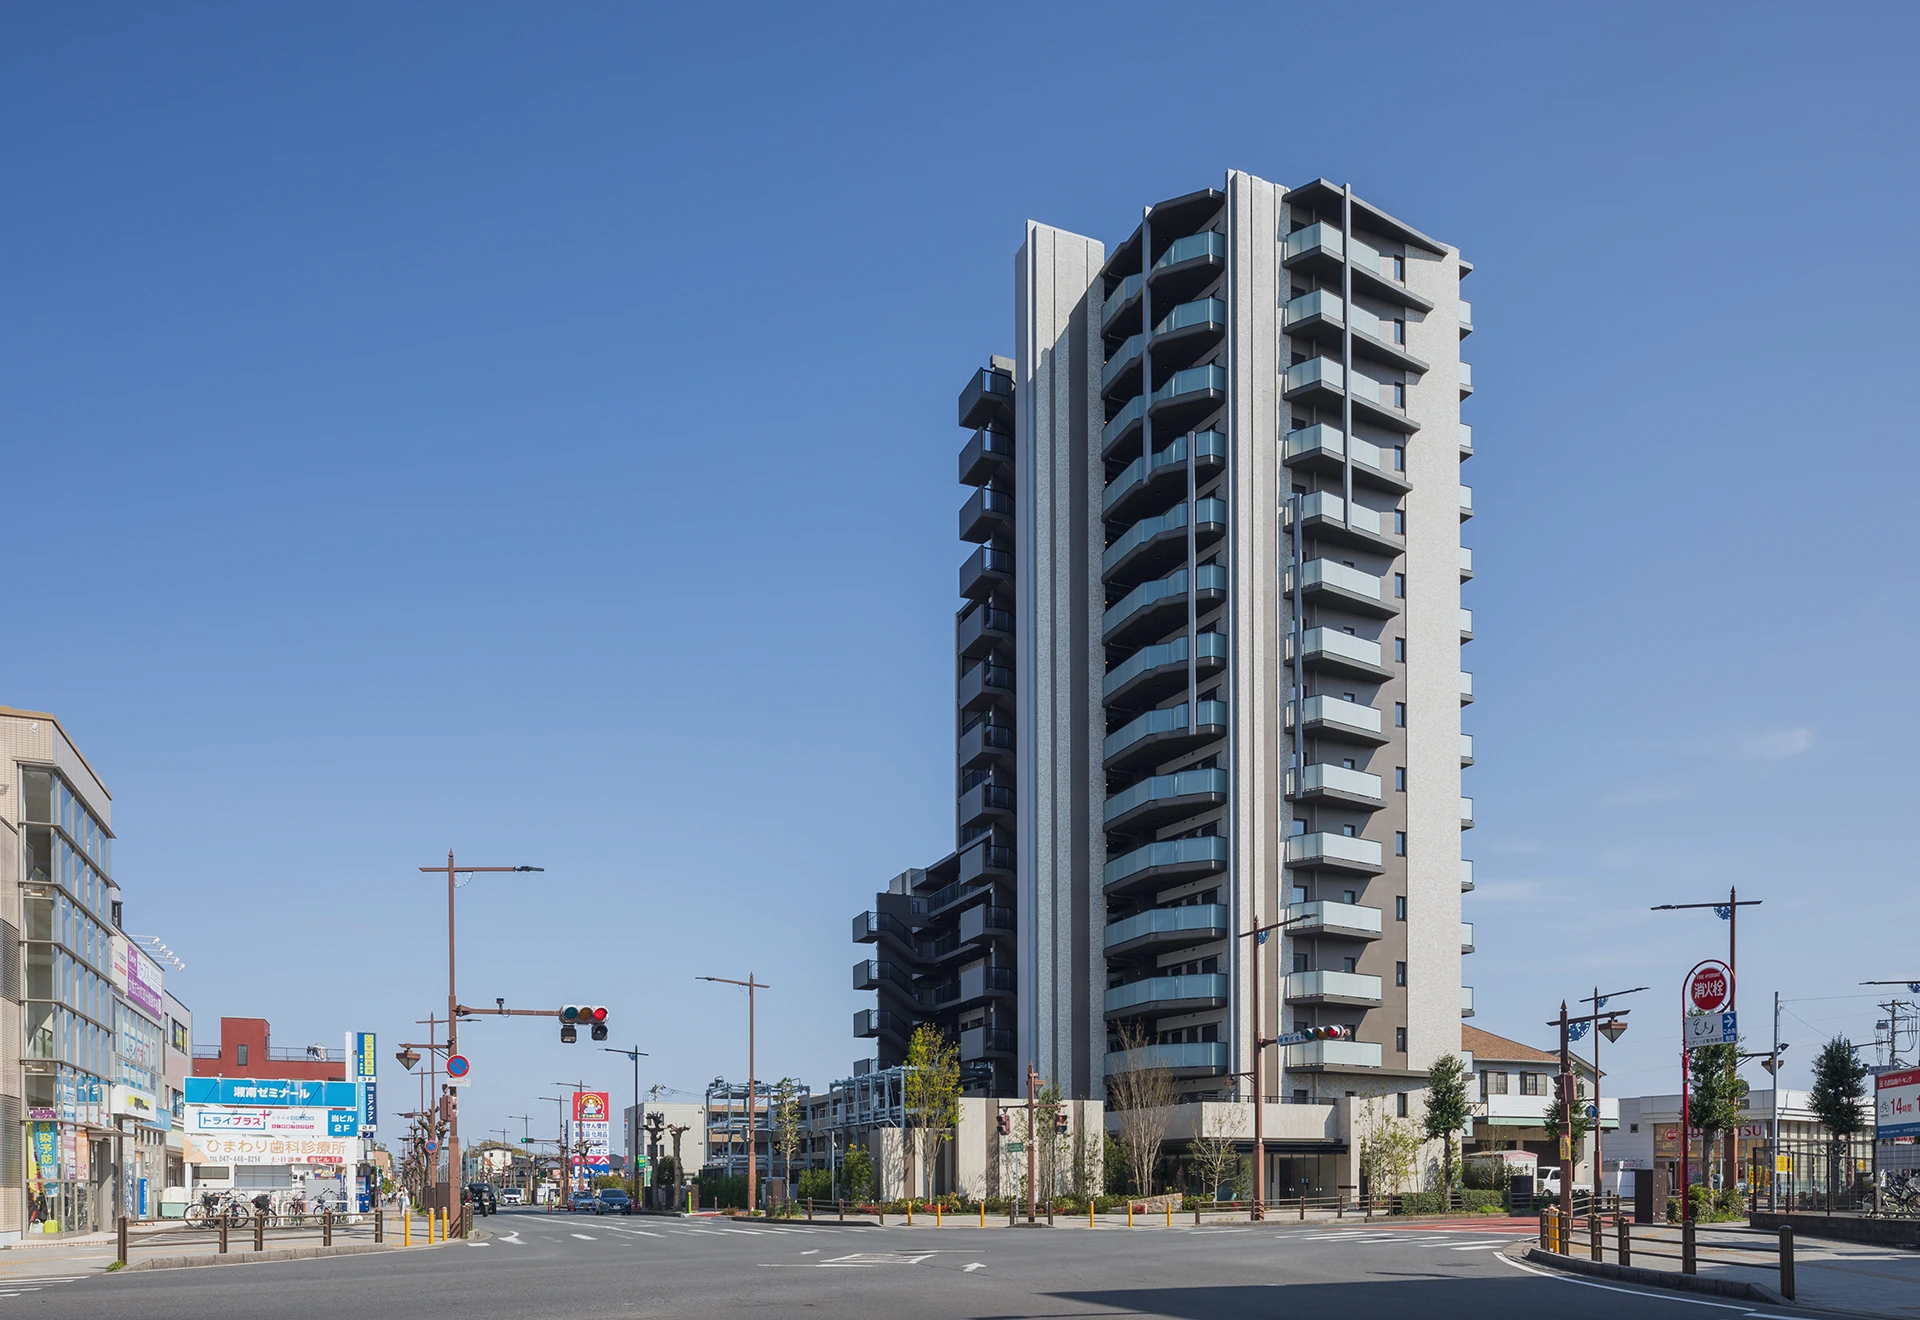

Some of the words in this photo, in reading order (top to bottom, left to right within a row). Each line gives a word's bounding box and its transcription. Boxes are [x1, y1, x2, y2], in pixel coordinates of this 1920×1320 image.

[1694, 980, 1725, 999] 消火栓
[233, 1086, 310, 1099] 湘南ゼミナール
[203, 1116, 261, 1126] トライプラス
[331, 1115, 355, 1123] 当ビル
[334, 1124, 350, 1132] 2F
[206, 1140, 346, 1155] ひまわり歯科診療所
